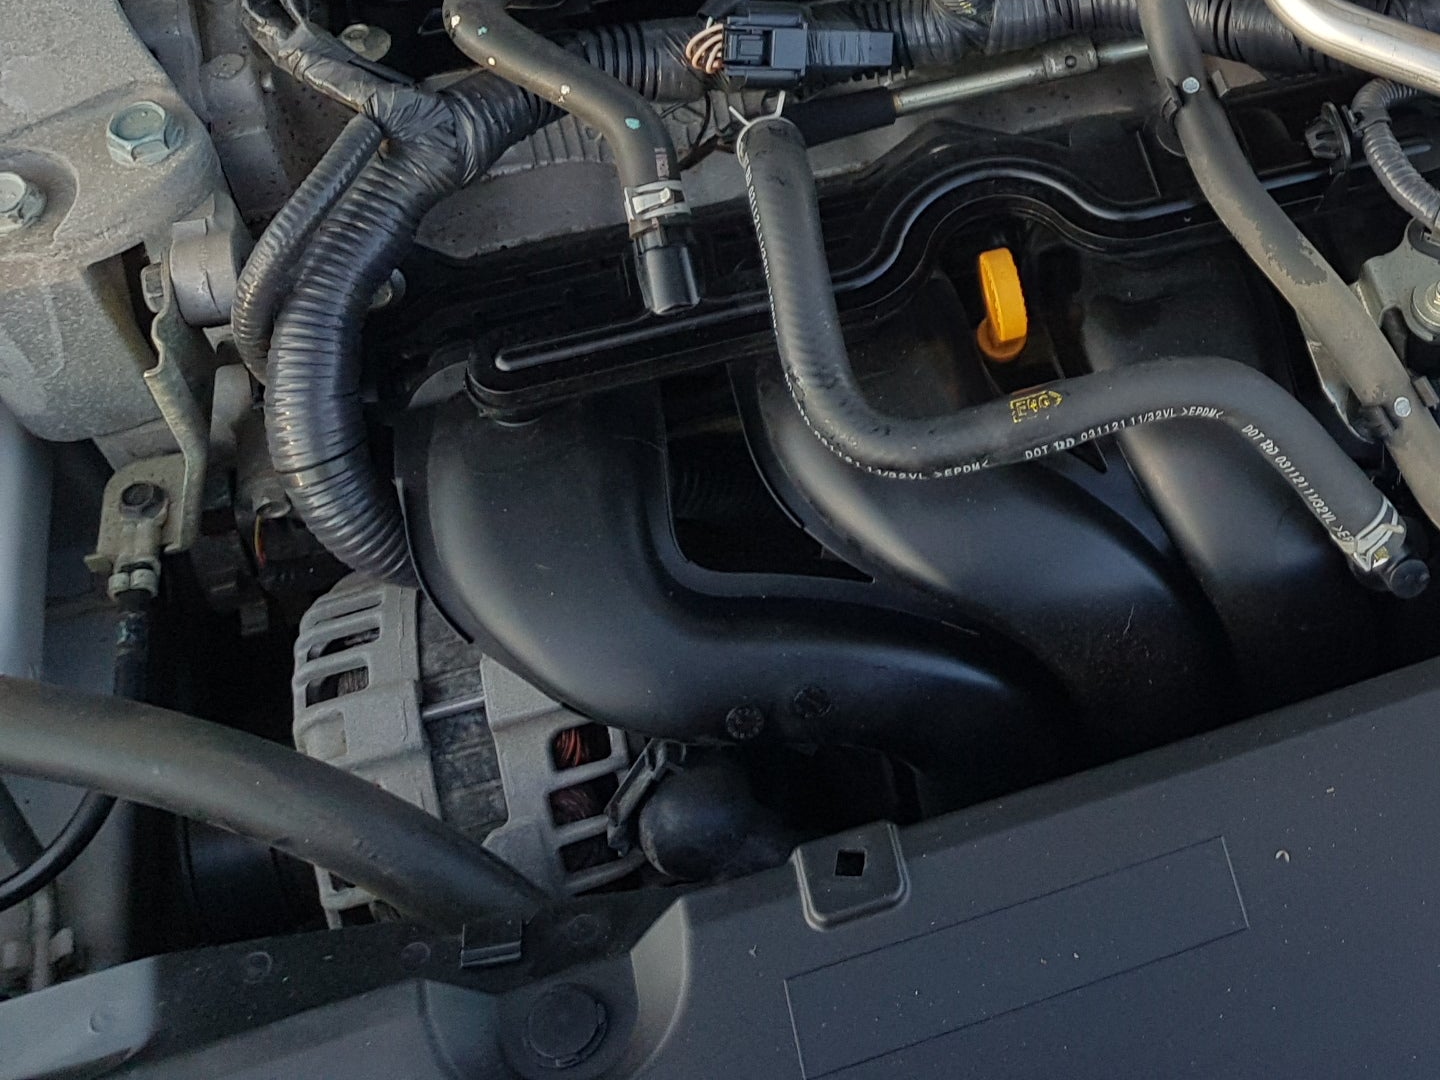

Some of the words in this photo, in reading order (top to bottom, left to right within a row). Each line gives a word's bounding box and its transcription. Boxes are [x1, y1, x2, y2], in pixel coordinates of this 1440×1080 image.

[1025, 445, 1049, 460] DOT
[1081, 420, 1125, 440] 031121
[1130, 408, 1176, 427] 11/32VL
[1182, 406, 1224, 419] >EPDM<
[1241, 424, 1265, 440] DOT
[1275, 456, 1308, 488] 031121
